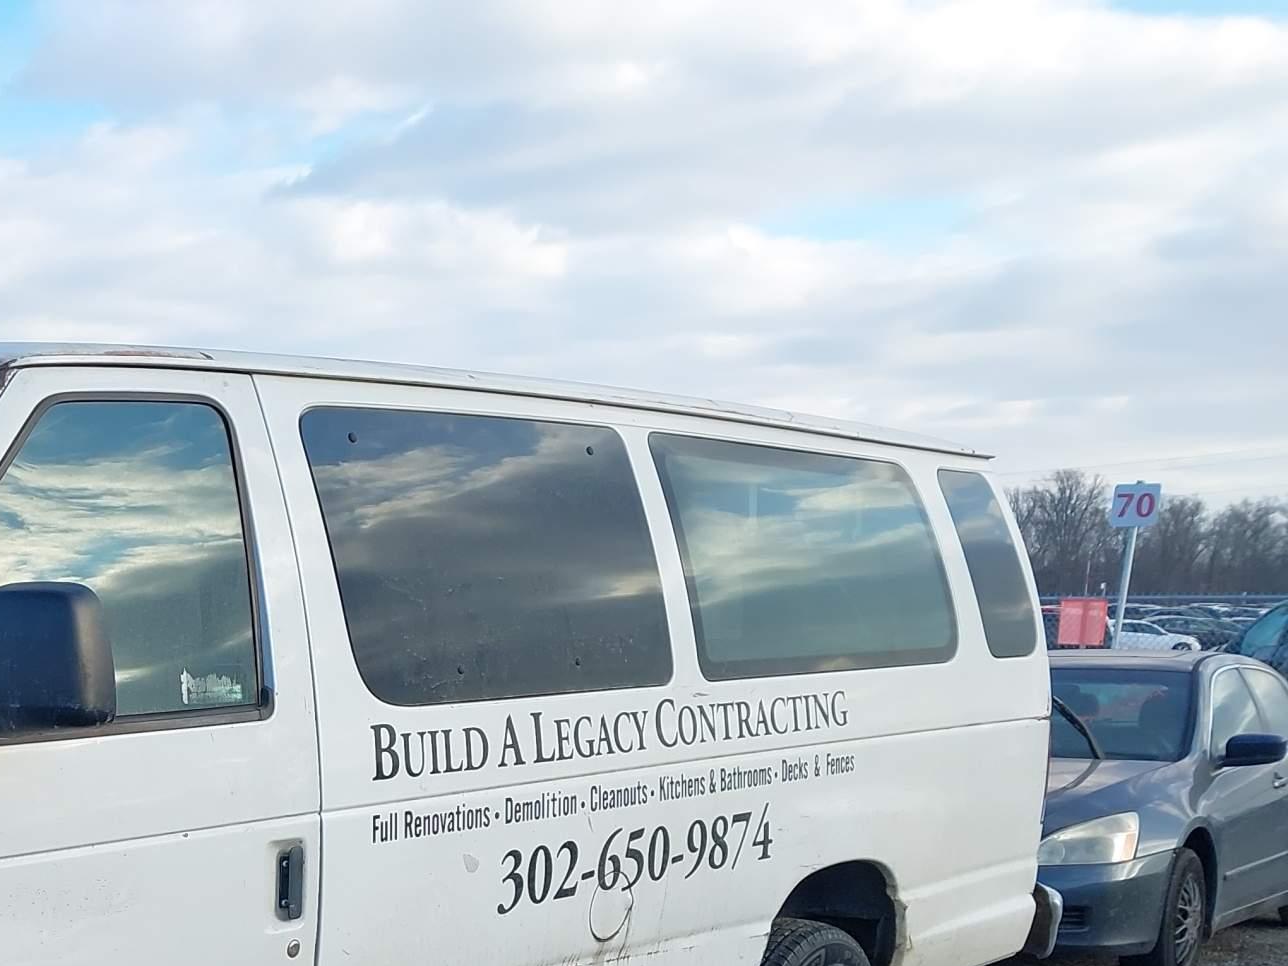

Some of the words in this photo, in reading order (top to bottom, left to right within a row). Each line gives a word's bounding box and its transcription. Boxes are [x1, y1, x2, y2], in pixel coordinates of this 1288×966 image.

[1116, 492, 1156, 519] 70
[497, 713, 527, 768] A
[372, 811, 399, 844] Full
[404, 804, 491, 839] Renovations
[505, 792, 578, 825] Demolition
[590, 781, 649, 812] Cleanouts
[659, 773, 706, 802] Kitchens
[708, 768, 717, 794] &
[720, 764, 773, 793] Bathrooms
[781, 757, 809, 783] Decks
[813, 754, 821, 777] &
[826, 753, 855, 777] Fences
[496, 802, 774, 915] 302-650-9874
